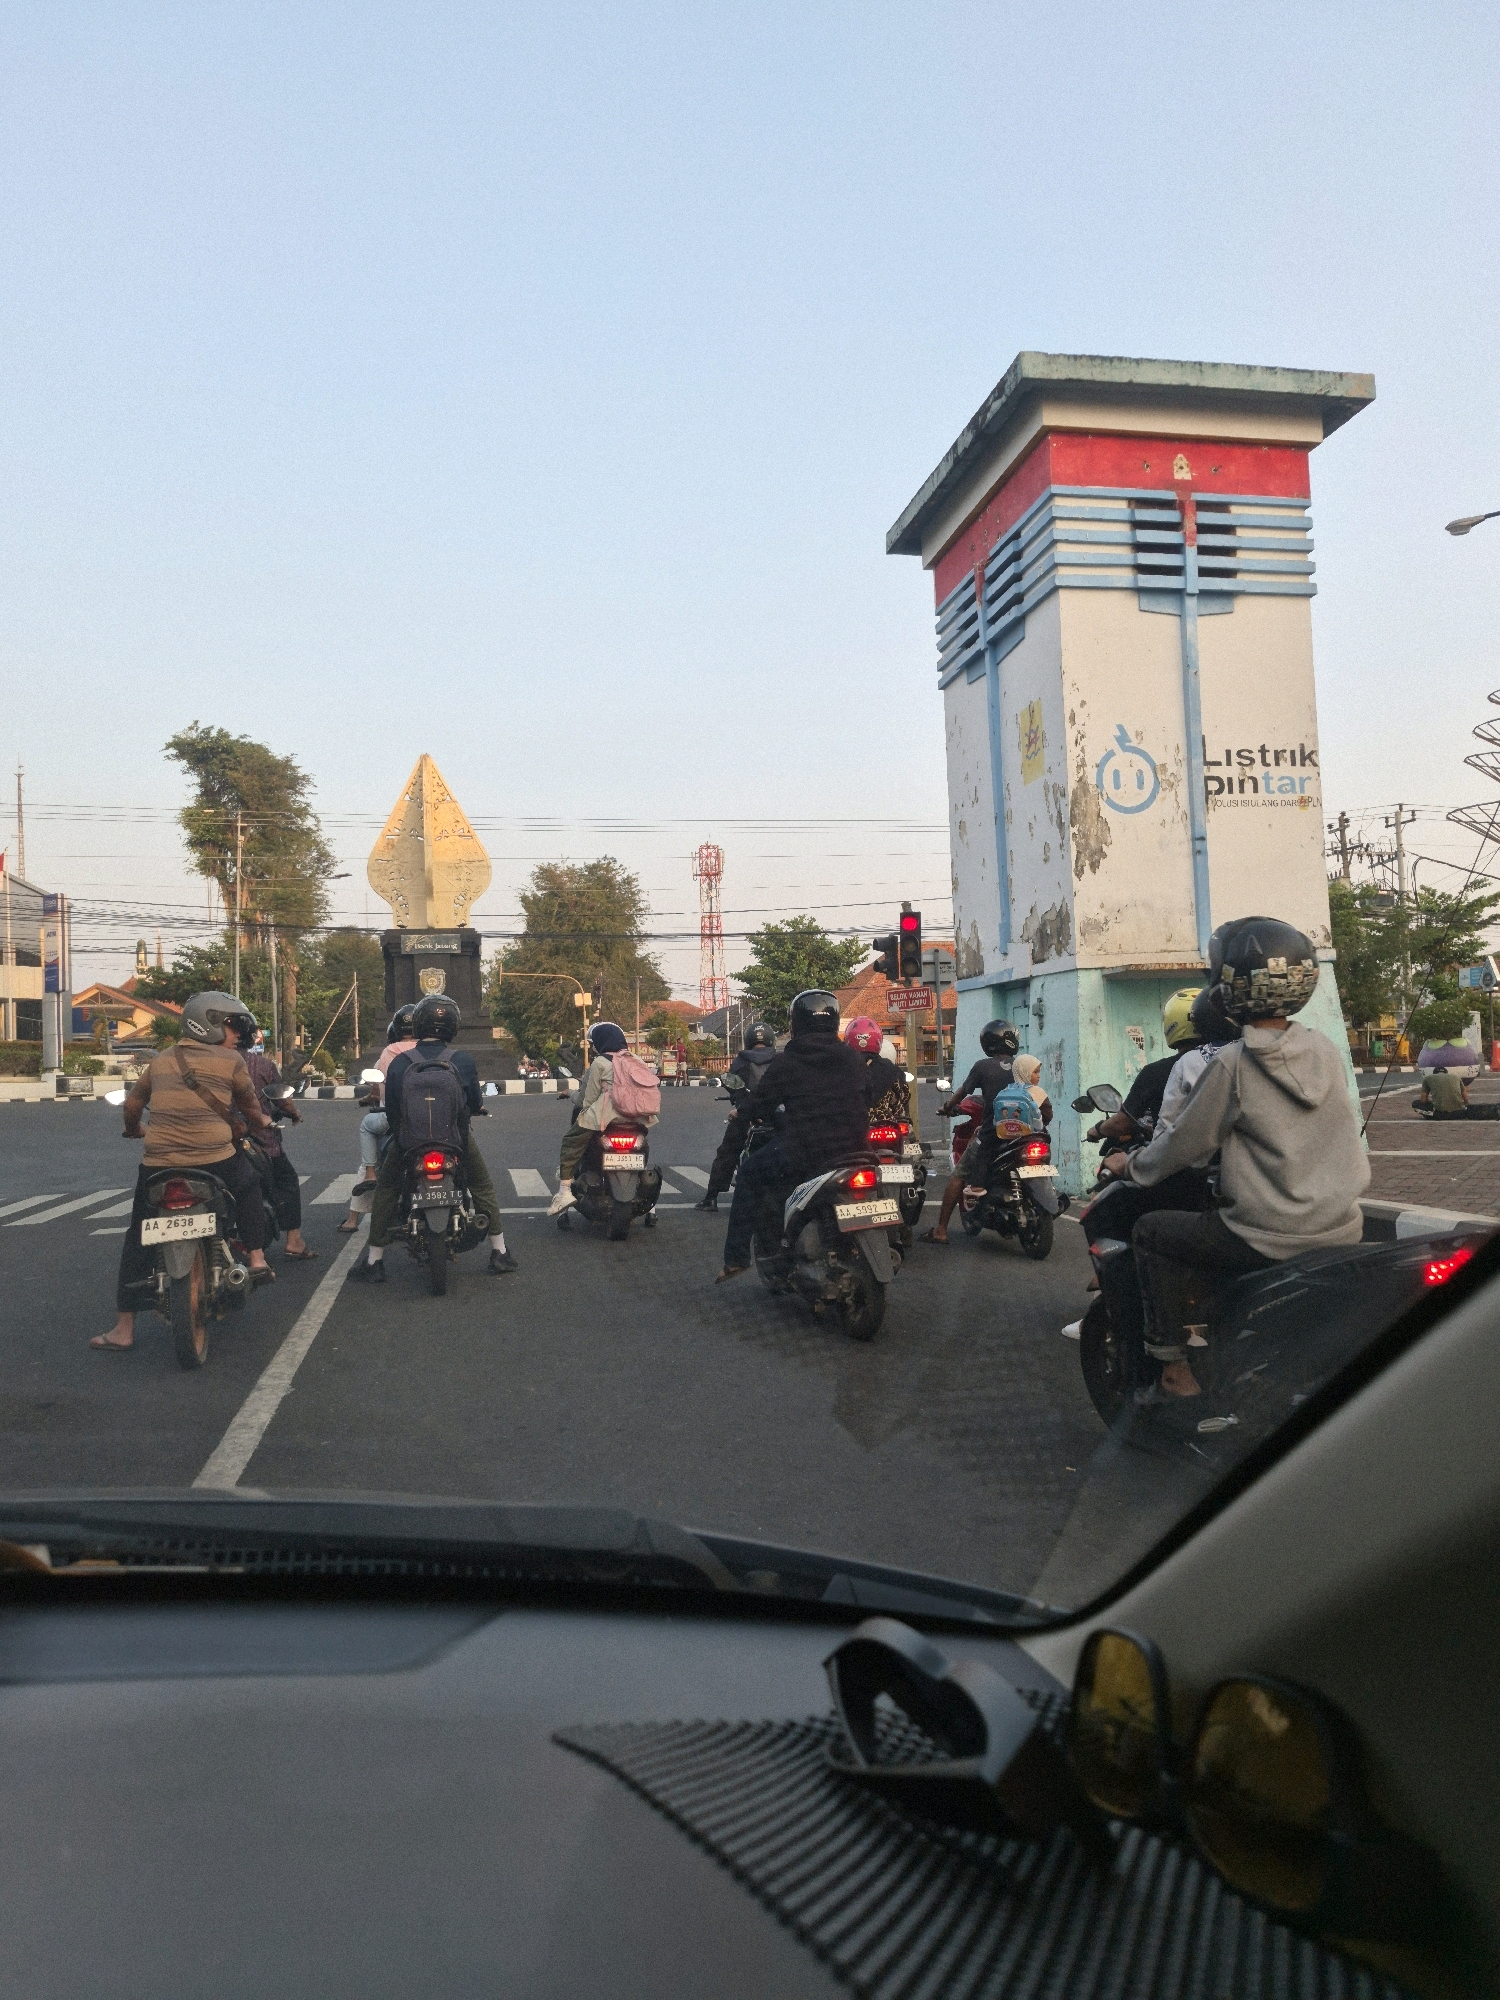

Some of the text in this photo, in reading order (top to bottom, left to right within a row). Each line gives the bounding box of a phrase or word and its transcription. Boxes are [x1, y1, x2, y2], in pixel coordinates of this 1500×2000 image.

[1202, 735, 1319, 767] Listrik
[1204, 771, 1312, 803] pintar
[1214, 799, 1239, 808] OLUSI
[411, 1193, 423, 1201] AA
[144, 1214, 215, 1231] AA 2638 C
